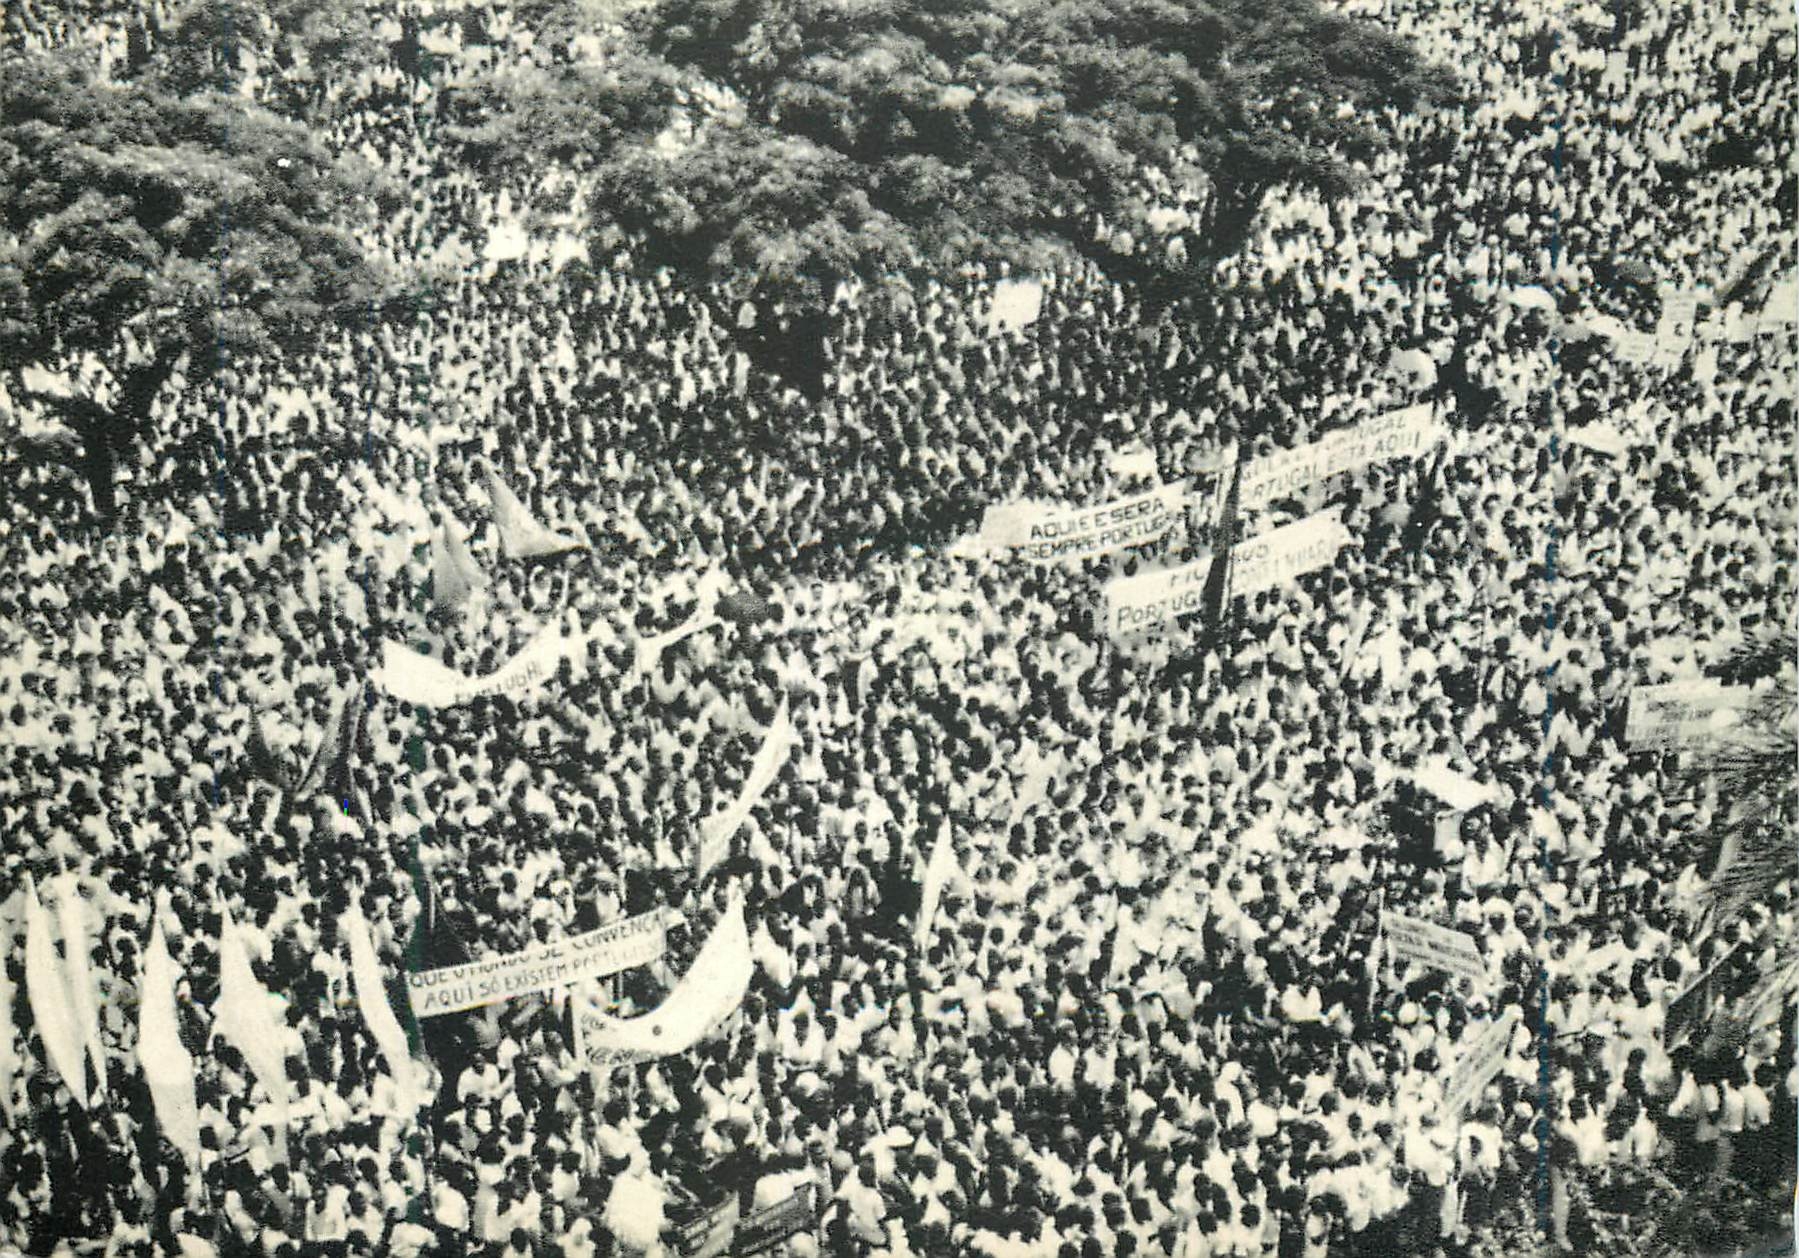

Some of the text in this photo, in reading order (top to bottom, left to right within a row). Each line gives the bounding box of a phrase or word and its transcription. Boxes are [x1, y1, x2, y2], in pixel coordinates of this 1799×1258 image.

[1030, 518, 1077, 541] AQUI
[1026, 533, 1095, 560] SEMPRE
[1115, 590, 1201, 631] PORTUG
[410, 969, 448, 989] QUE
